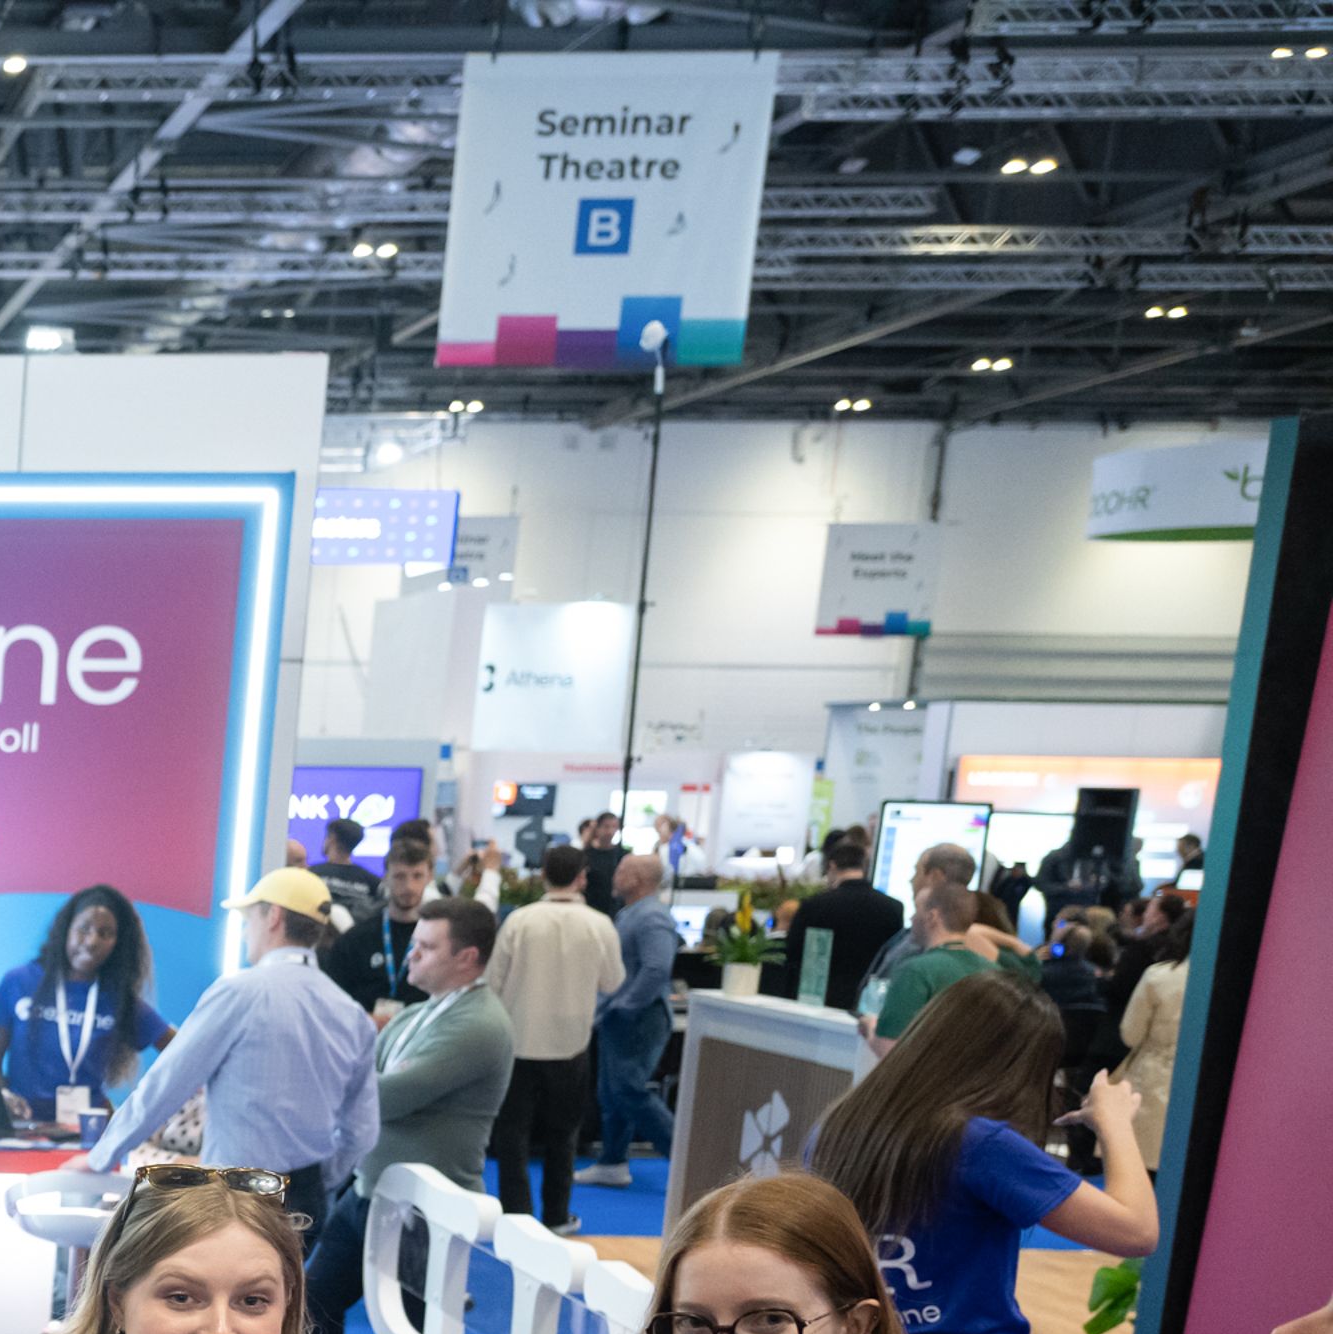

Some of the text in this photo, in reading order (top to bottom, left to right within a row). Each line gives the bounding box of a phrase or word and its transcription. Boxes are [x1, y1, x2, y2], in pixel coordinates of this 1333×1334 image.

[536, 107, 693, 138] Seminar
[538, 153, 681, 180] Theatre
[586, 208, 622, 246] B
[505, 668, 574, 689] Athena
